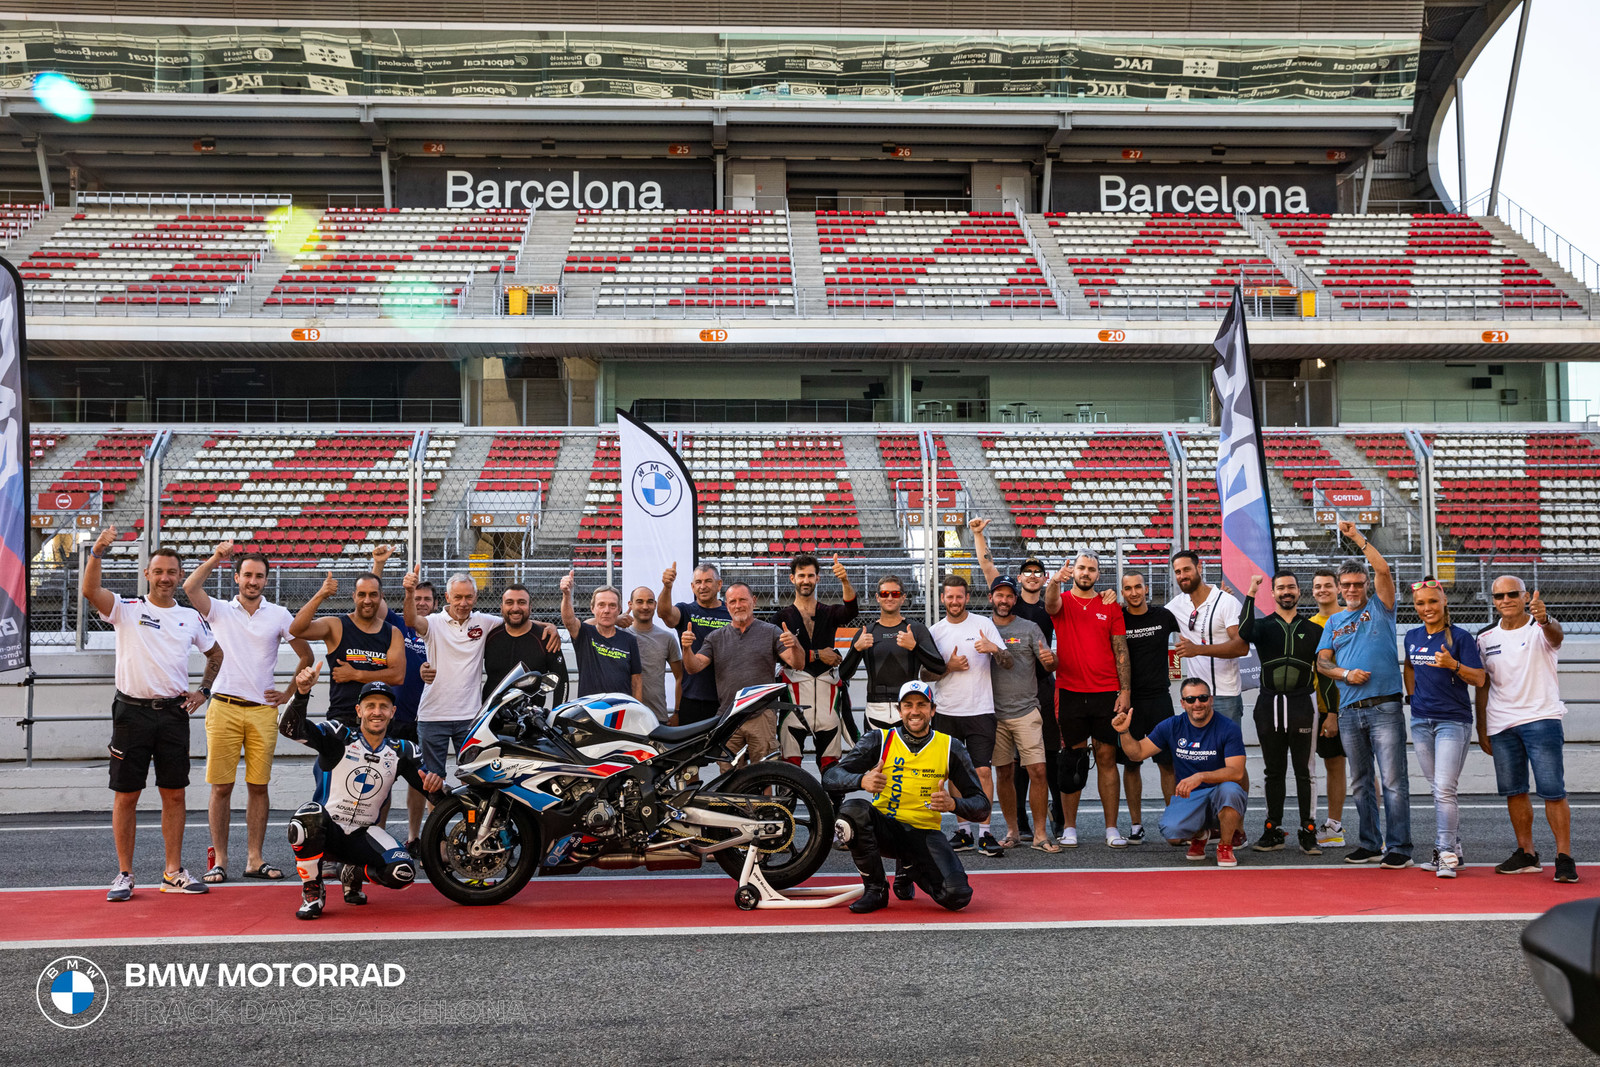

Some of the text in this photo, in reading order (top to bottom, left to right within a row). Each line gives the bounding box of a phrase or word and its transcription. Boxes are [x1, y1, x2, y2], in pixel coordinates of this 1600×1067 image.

[431, 143, 443, 152] 24
[677, 145, 689, 154] 25
[898, 148, 910, 157] 26
[1129, 151, 1141, 159] 27
[1334, 152, 1346, 160] 28
[446, 170, 664, 209] Barcelona
[1099, 175, 1310, 213] Barcelona
[303, 330, 318, 341] 18
[710, 330, 726, 341] 19
[1107, 331, 1123, 342] 20
[1491, 331, 1506, 342] 21
[1332, 494, 1363, 502] SORTIDA
[39, 517, 91, 525] 17 18
[480, 516, 531, 524] 18 19
[908, 515, 919, 523] 19
[1323, 513, 1372, 521] 20 21
[1134, 625, 1163, 634] MOTORRAD
[346, 648, 386, 660] QUIKSILVE
[1175, 753, 1209, 761] MOTORSPORT
[354, 767, 380, 780] BMW
[886, 756, 906, 819] RACKDAYS
[760, 881, 773, 898] Motorrad
